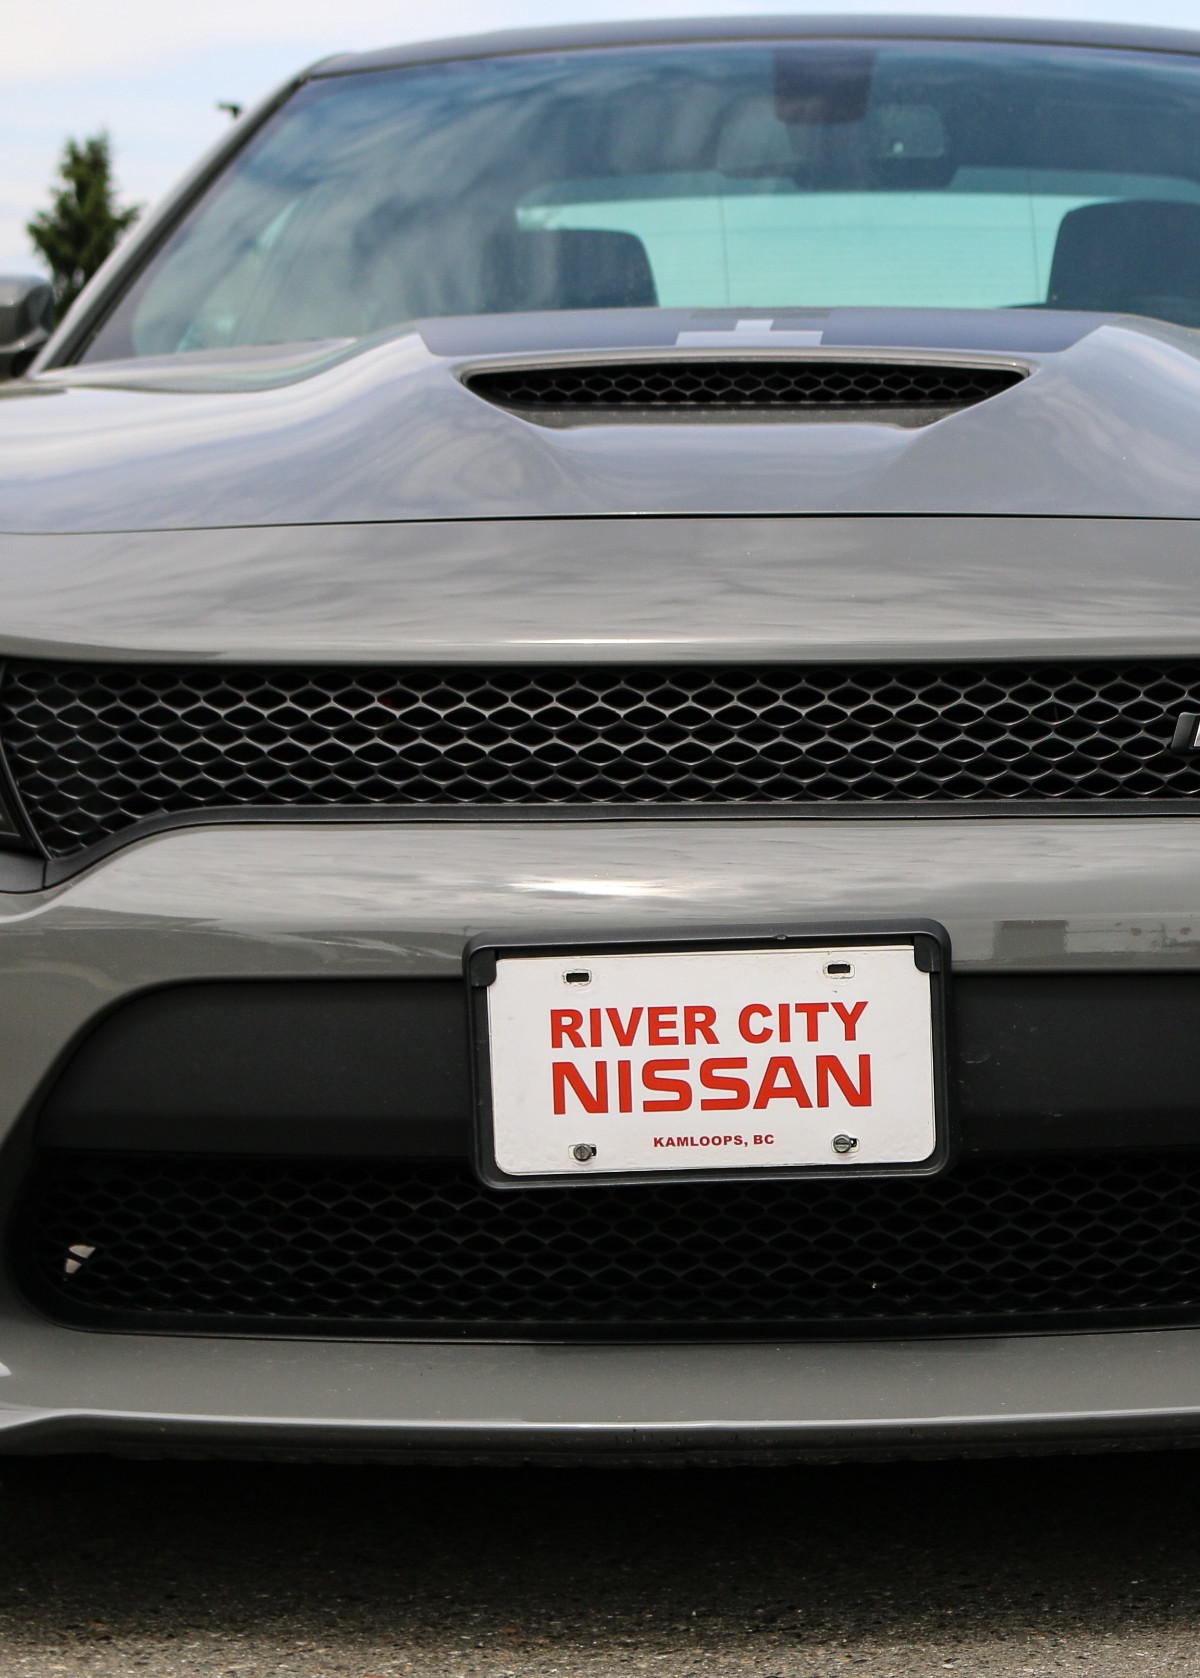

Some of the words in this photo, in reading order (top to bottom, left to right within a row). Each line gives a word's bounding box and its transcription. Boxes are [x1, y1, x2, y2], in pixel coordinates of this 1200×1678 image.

[550, 1005, 720, 1049] RIVER
[738, 1001, 869, 1044] CITY
[552, 1054, 873, 1116] NISSAN
[653, 1135, 748, 1148] KAMLOOPS,
[753, 1134, 774, 1145] BC
